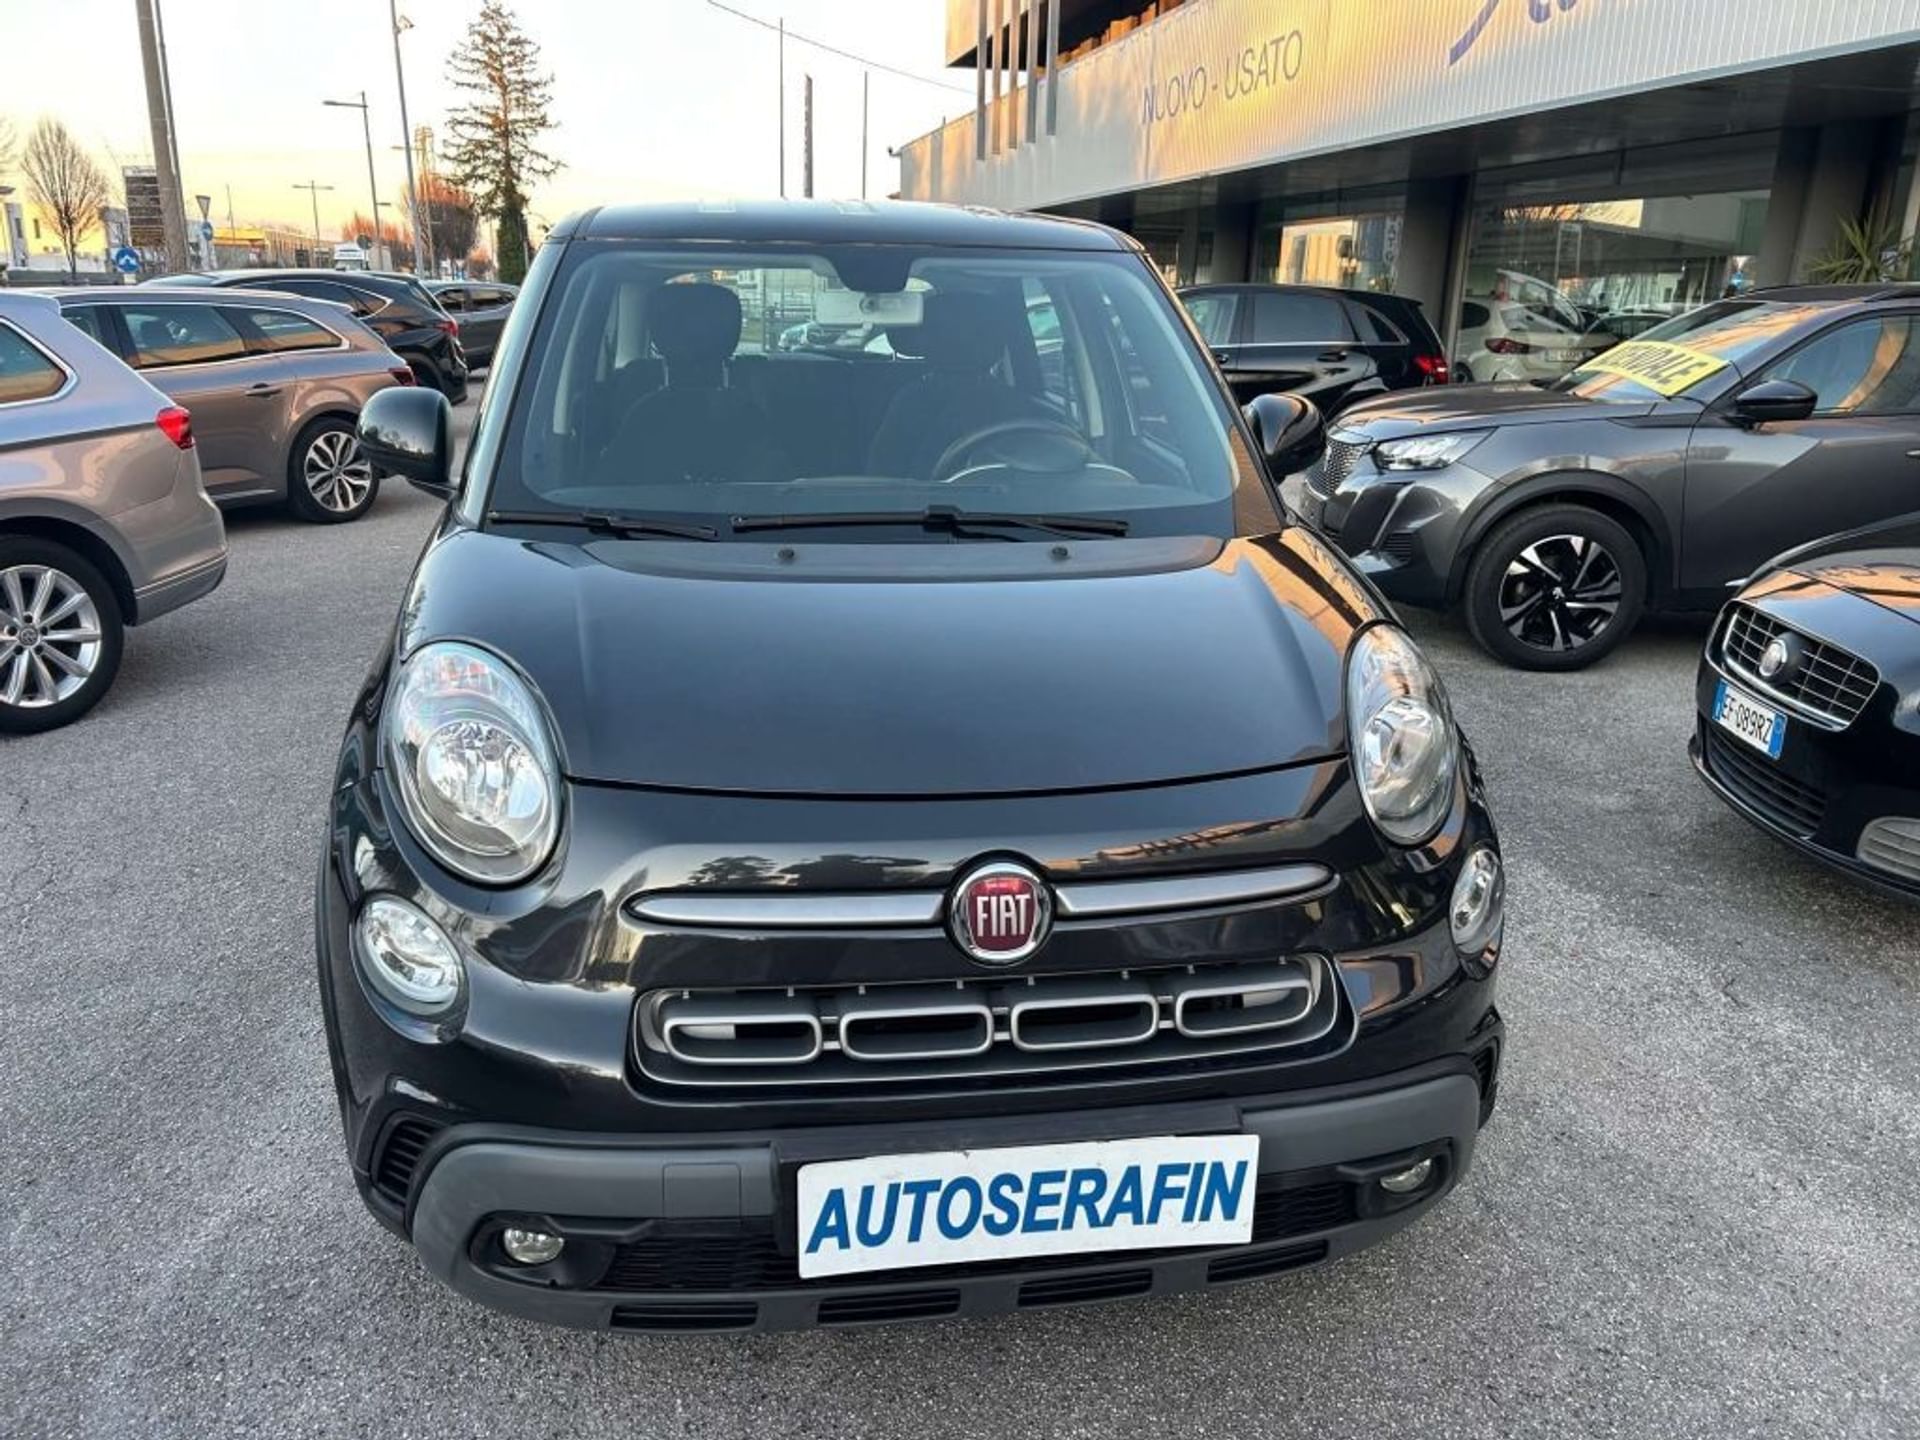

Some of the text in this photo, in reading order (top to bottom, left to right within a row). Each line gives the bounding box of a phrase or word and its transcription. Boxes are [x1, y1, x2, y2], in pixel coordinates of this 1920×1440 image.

[1142, 66, 1207, 124] NUOVO
[1224, 30, 1303, 99] USATO
[976, 894, 1031, 937] FIAT
[804, 1160, 1249, 1254] AUTOSERAFIN
